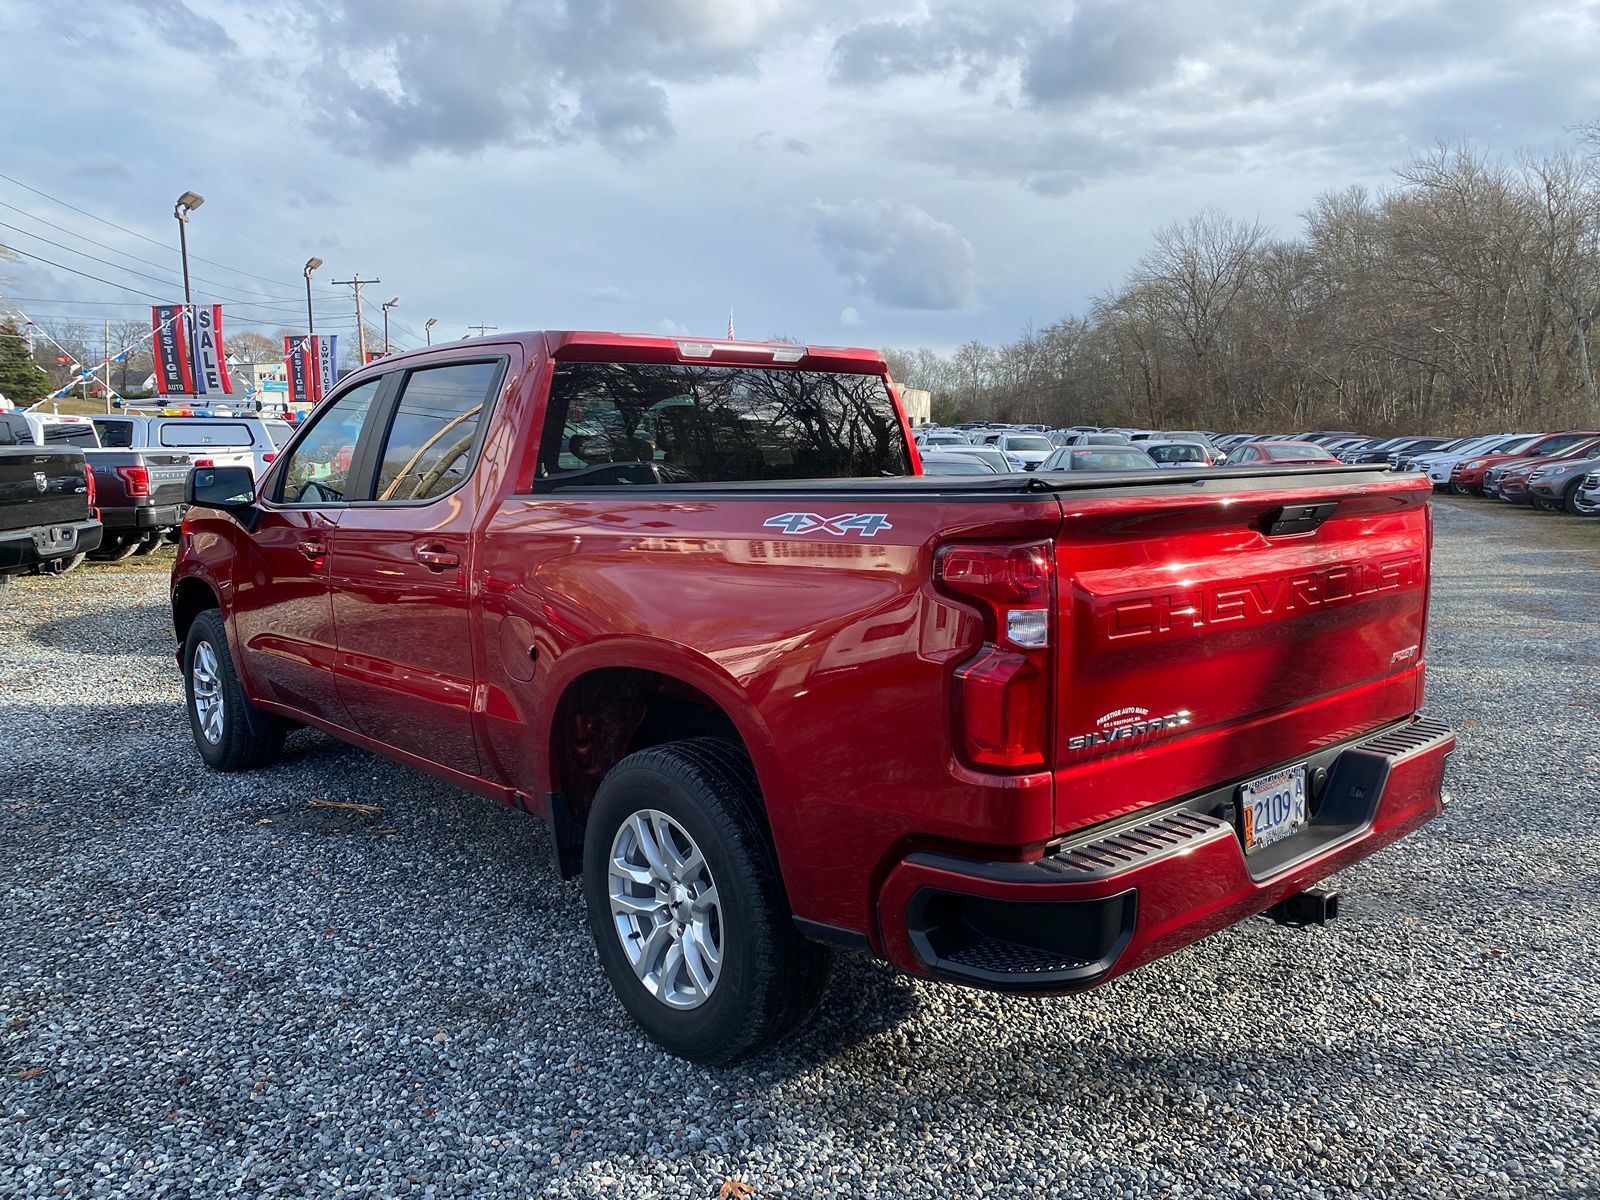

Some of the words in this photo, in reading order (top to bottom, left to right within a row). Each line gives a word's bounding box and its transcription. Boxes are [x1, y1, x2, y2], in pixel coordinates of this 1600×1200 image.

[161, 311, 178, 380] PRESTIGE
[199, 310, 220, 389] SALE
[293, 340, 304, 391] PRESTIGE
[167, 383, 184, 391] AUTO
[1107, 557, 1421, 640] CHEVROLET
[1068, 709, 1191, 749] SILVERADO
[1096, 709, 1121, 726] PRESTIGE
[1121, 707, 1135, 715] AUTO
[1135, 707, 1149, 716] MART
[1254, 789, 1291, 833] 2109
